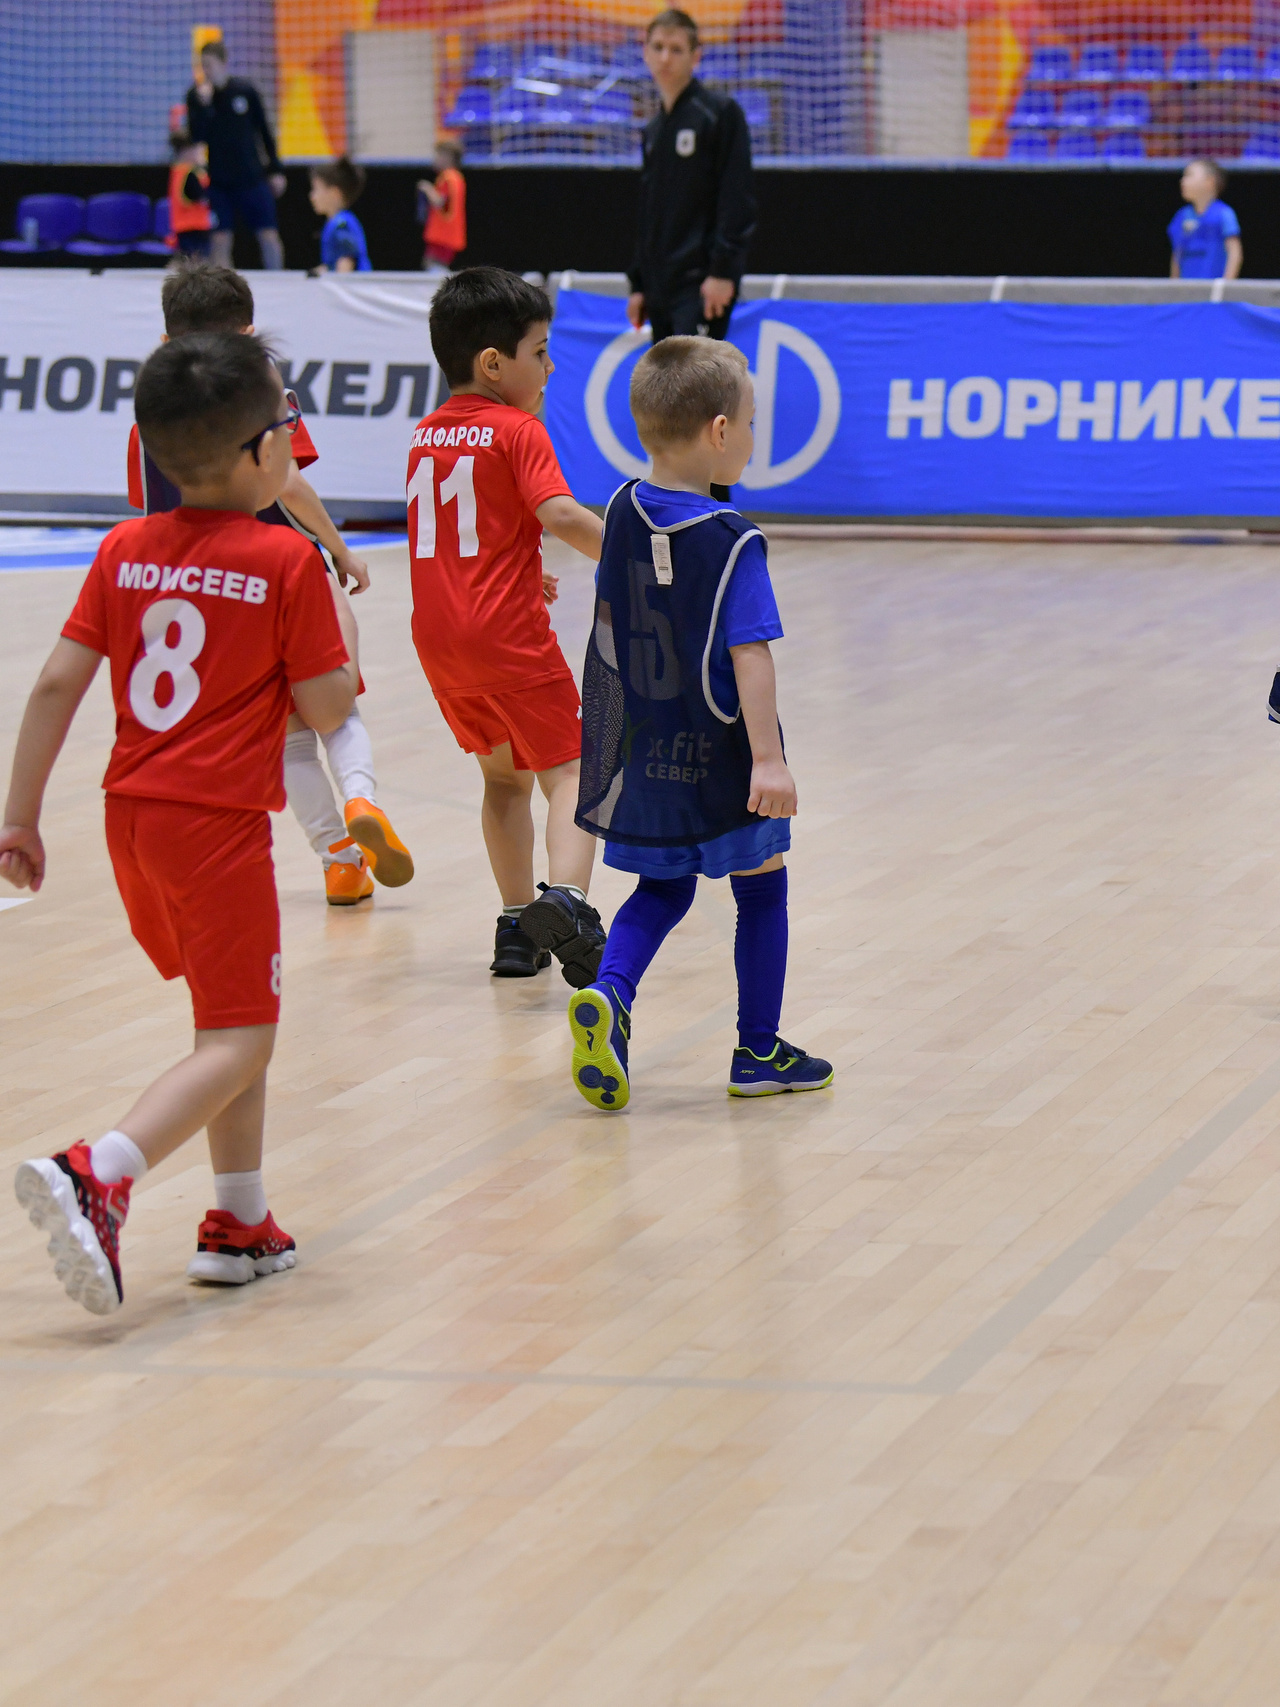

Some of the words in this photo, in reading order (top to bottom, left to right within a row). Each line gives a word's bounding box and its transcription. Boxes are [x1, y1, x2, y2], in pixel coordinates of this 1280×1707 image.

[0, 356, 450, 418] НОРКЕЛ
[410, 426, 494, 450] ЖАФАРОВ
[407, 456, 479, 558] 11
[117, 562, 269, 604] МОИСЕЕВ
[628, 559, 681, 701] 5
[129, 598, 206, 732] 8
[645, 762, 708, 785] СЕВЕР
